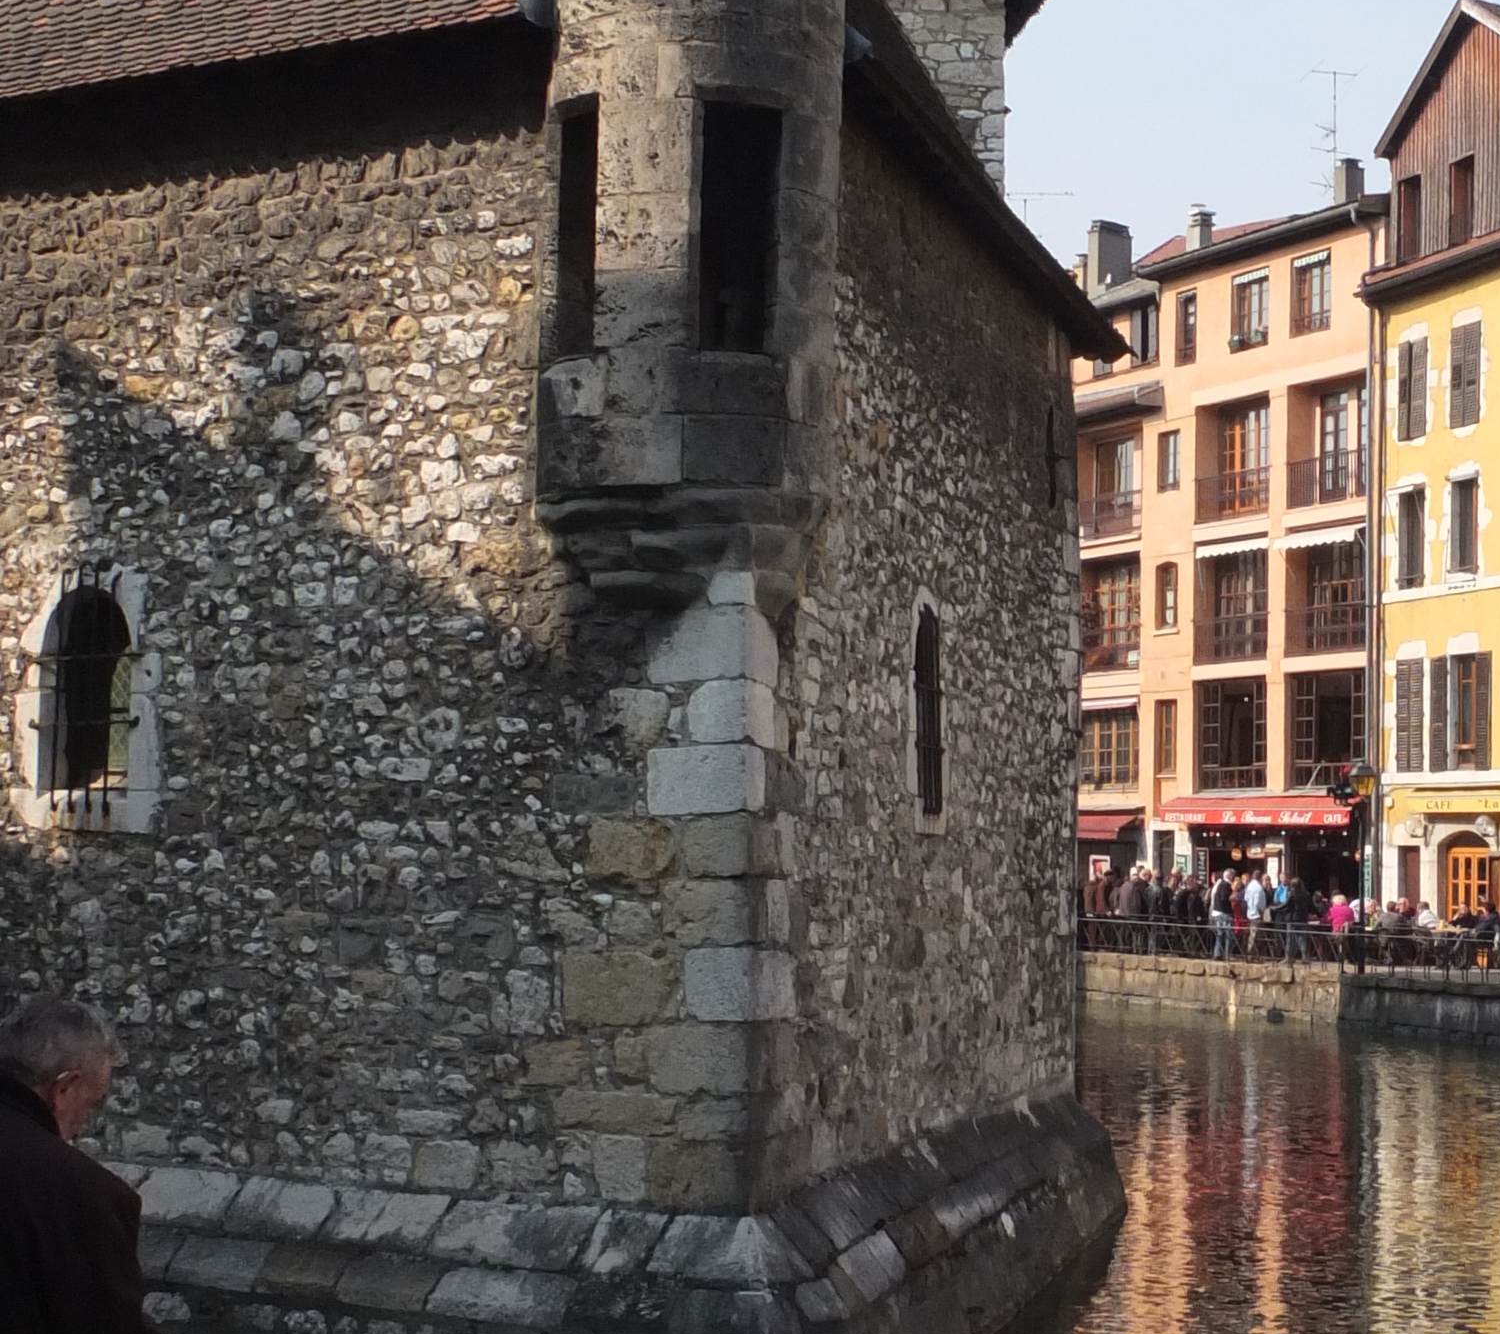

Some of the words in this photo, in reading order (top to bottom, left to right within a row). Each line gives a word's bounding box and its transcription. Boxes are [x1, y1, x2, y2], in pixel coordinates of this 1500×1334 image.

[1165, 812, 1206, 822] RESTAURANT
[1221, 810, 1237, 823] Le
[1241, 810, 1272, 823] Beau
[1277, 810, 1312, 824] Soleil
